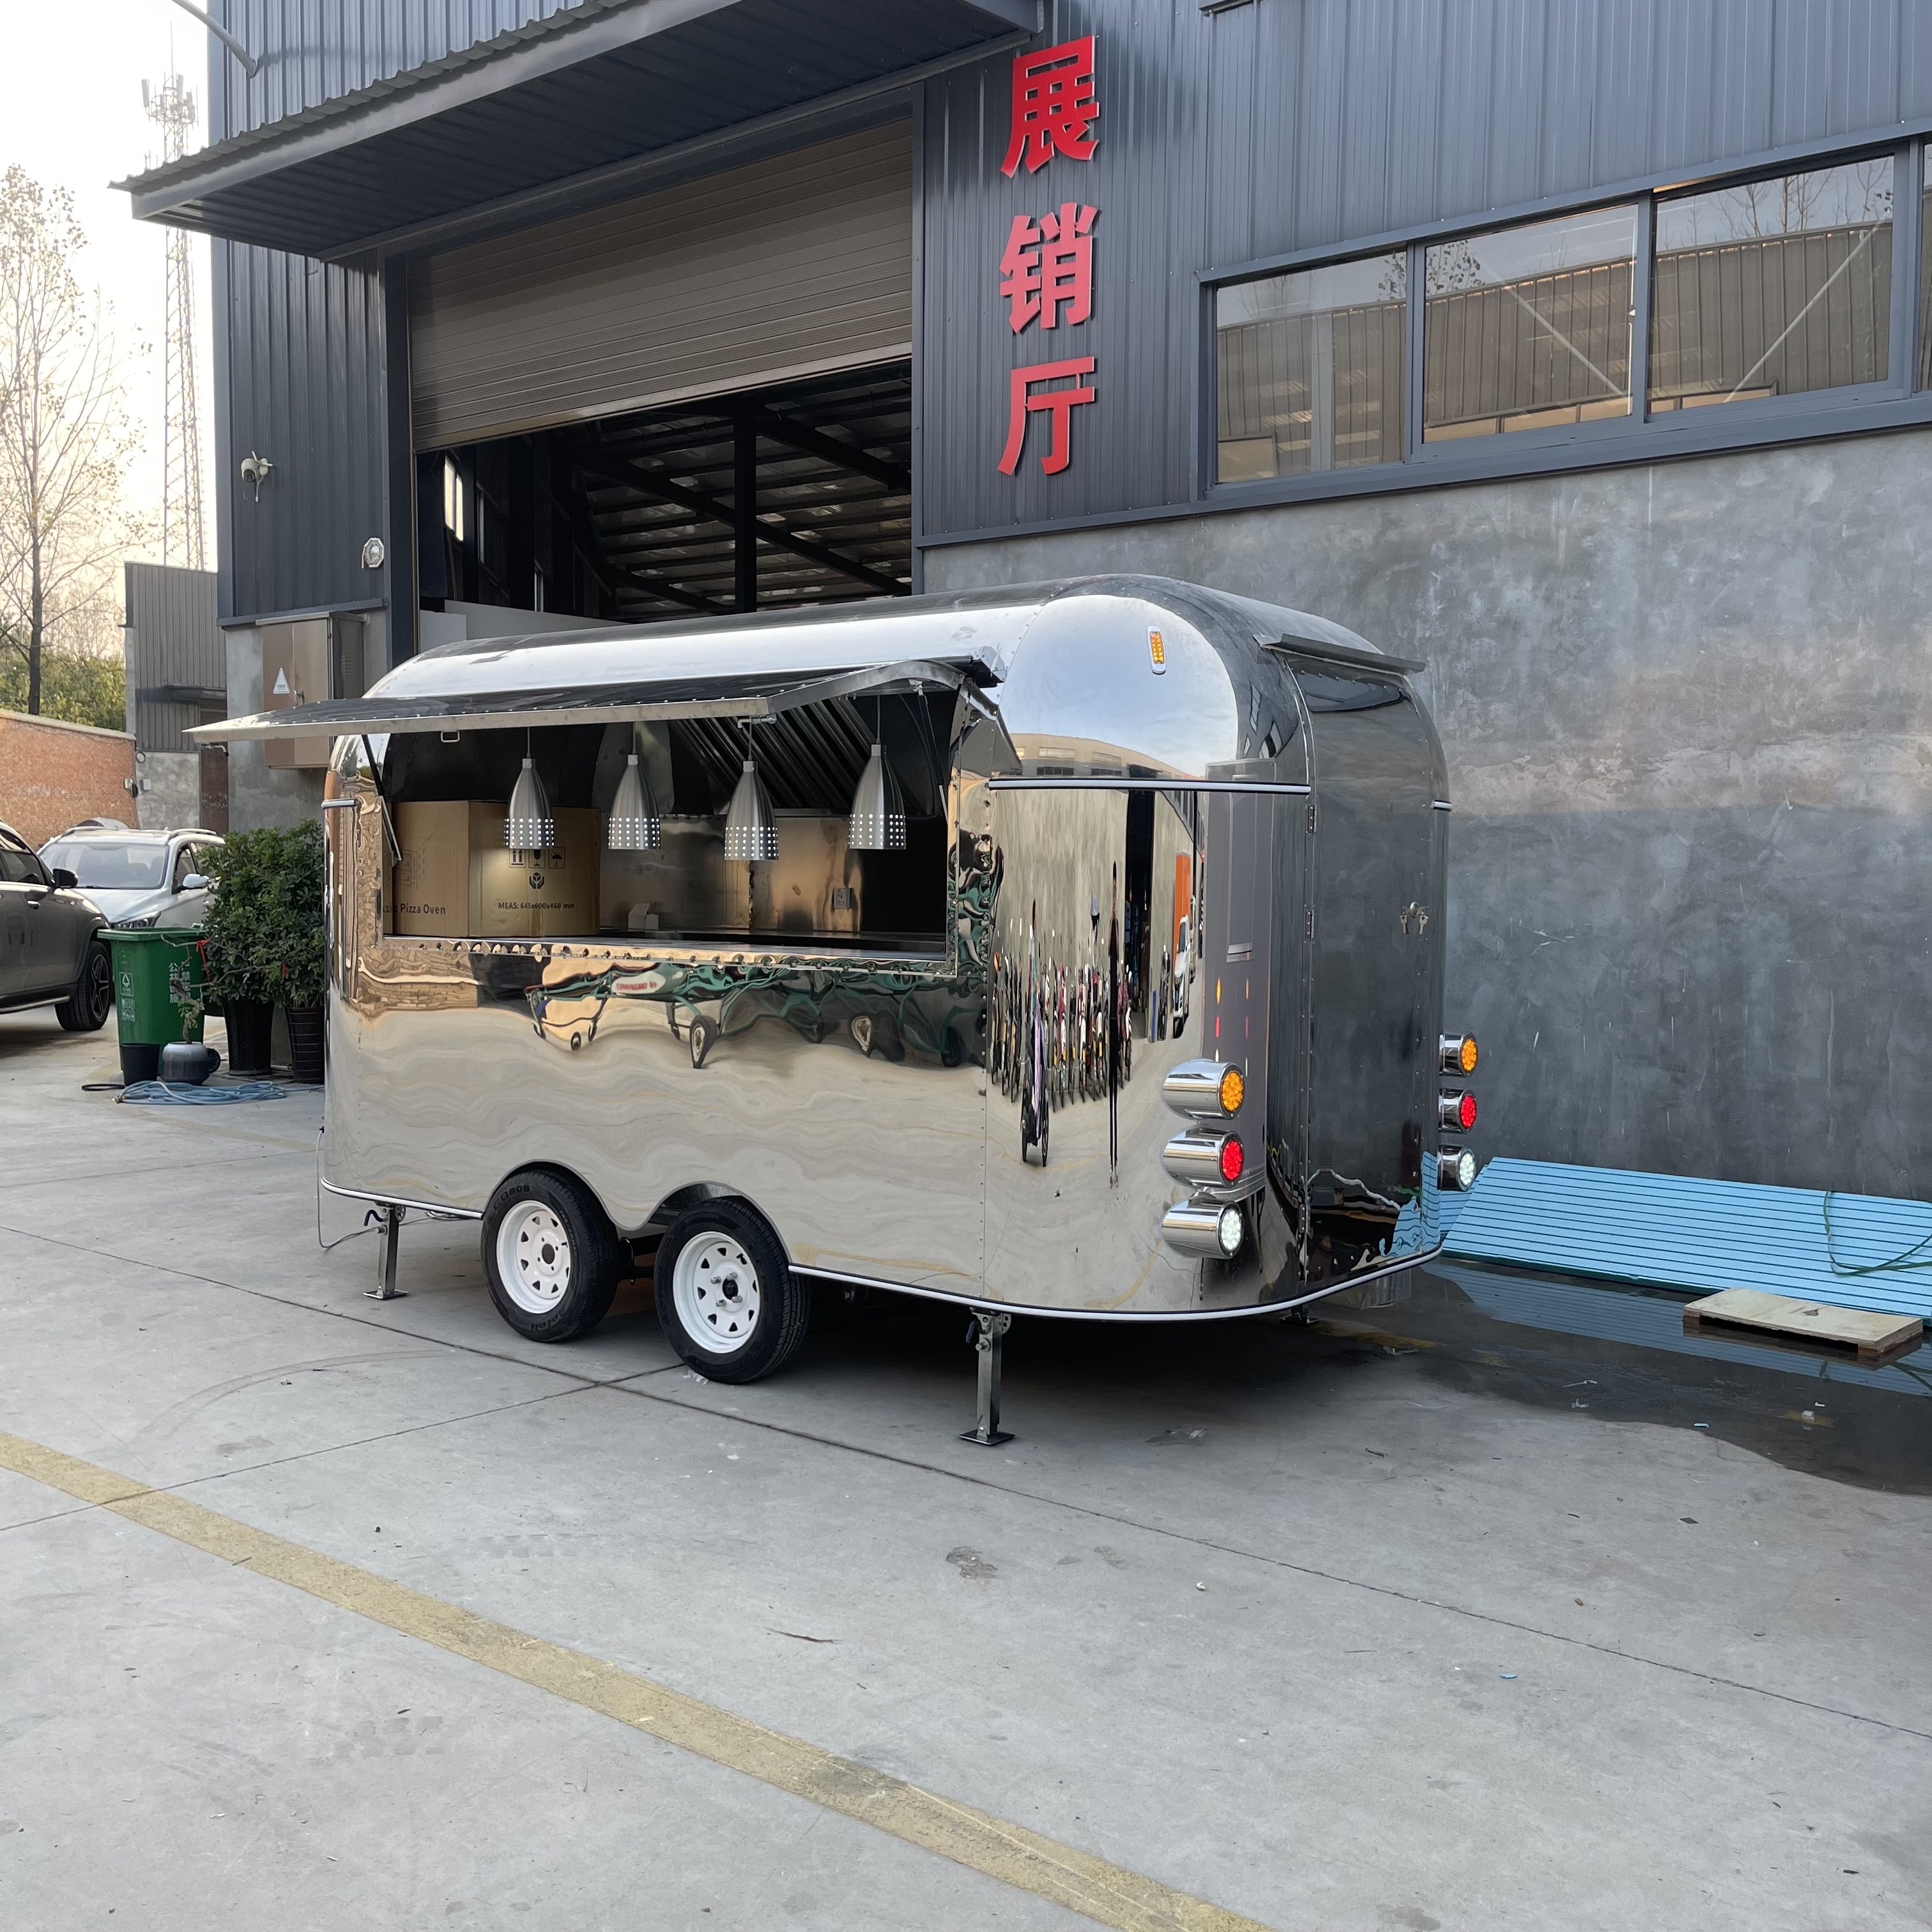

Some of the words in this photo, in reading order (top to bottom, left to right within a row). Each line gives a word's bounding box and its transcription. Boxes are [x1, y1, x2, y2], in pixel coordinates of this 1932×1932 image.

[997, 34, 1100, 476] 展销厅
[400, 903, 421, 914] Pizza
[423, 904, 446, 914] Oven
